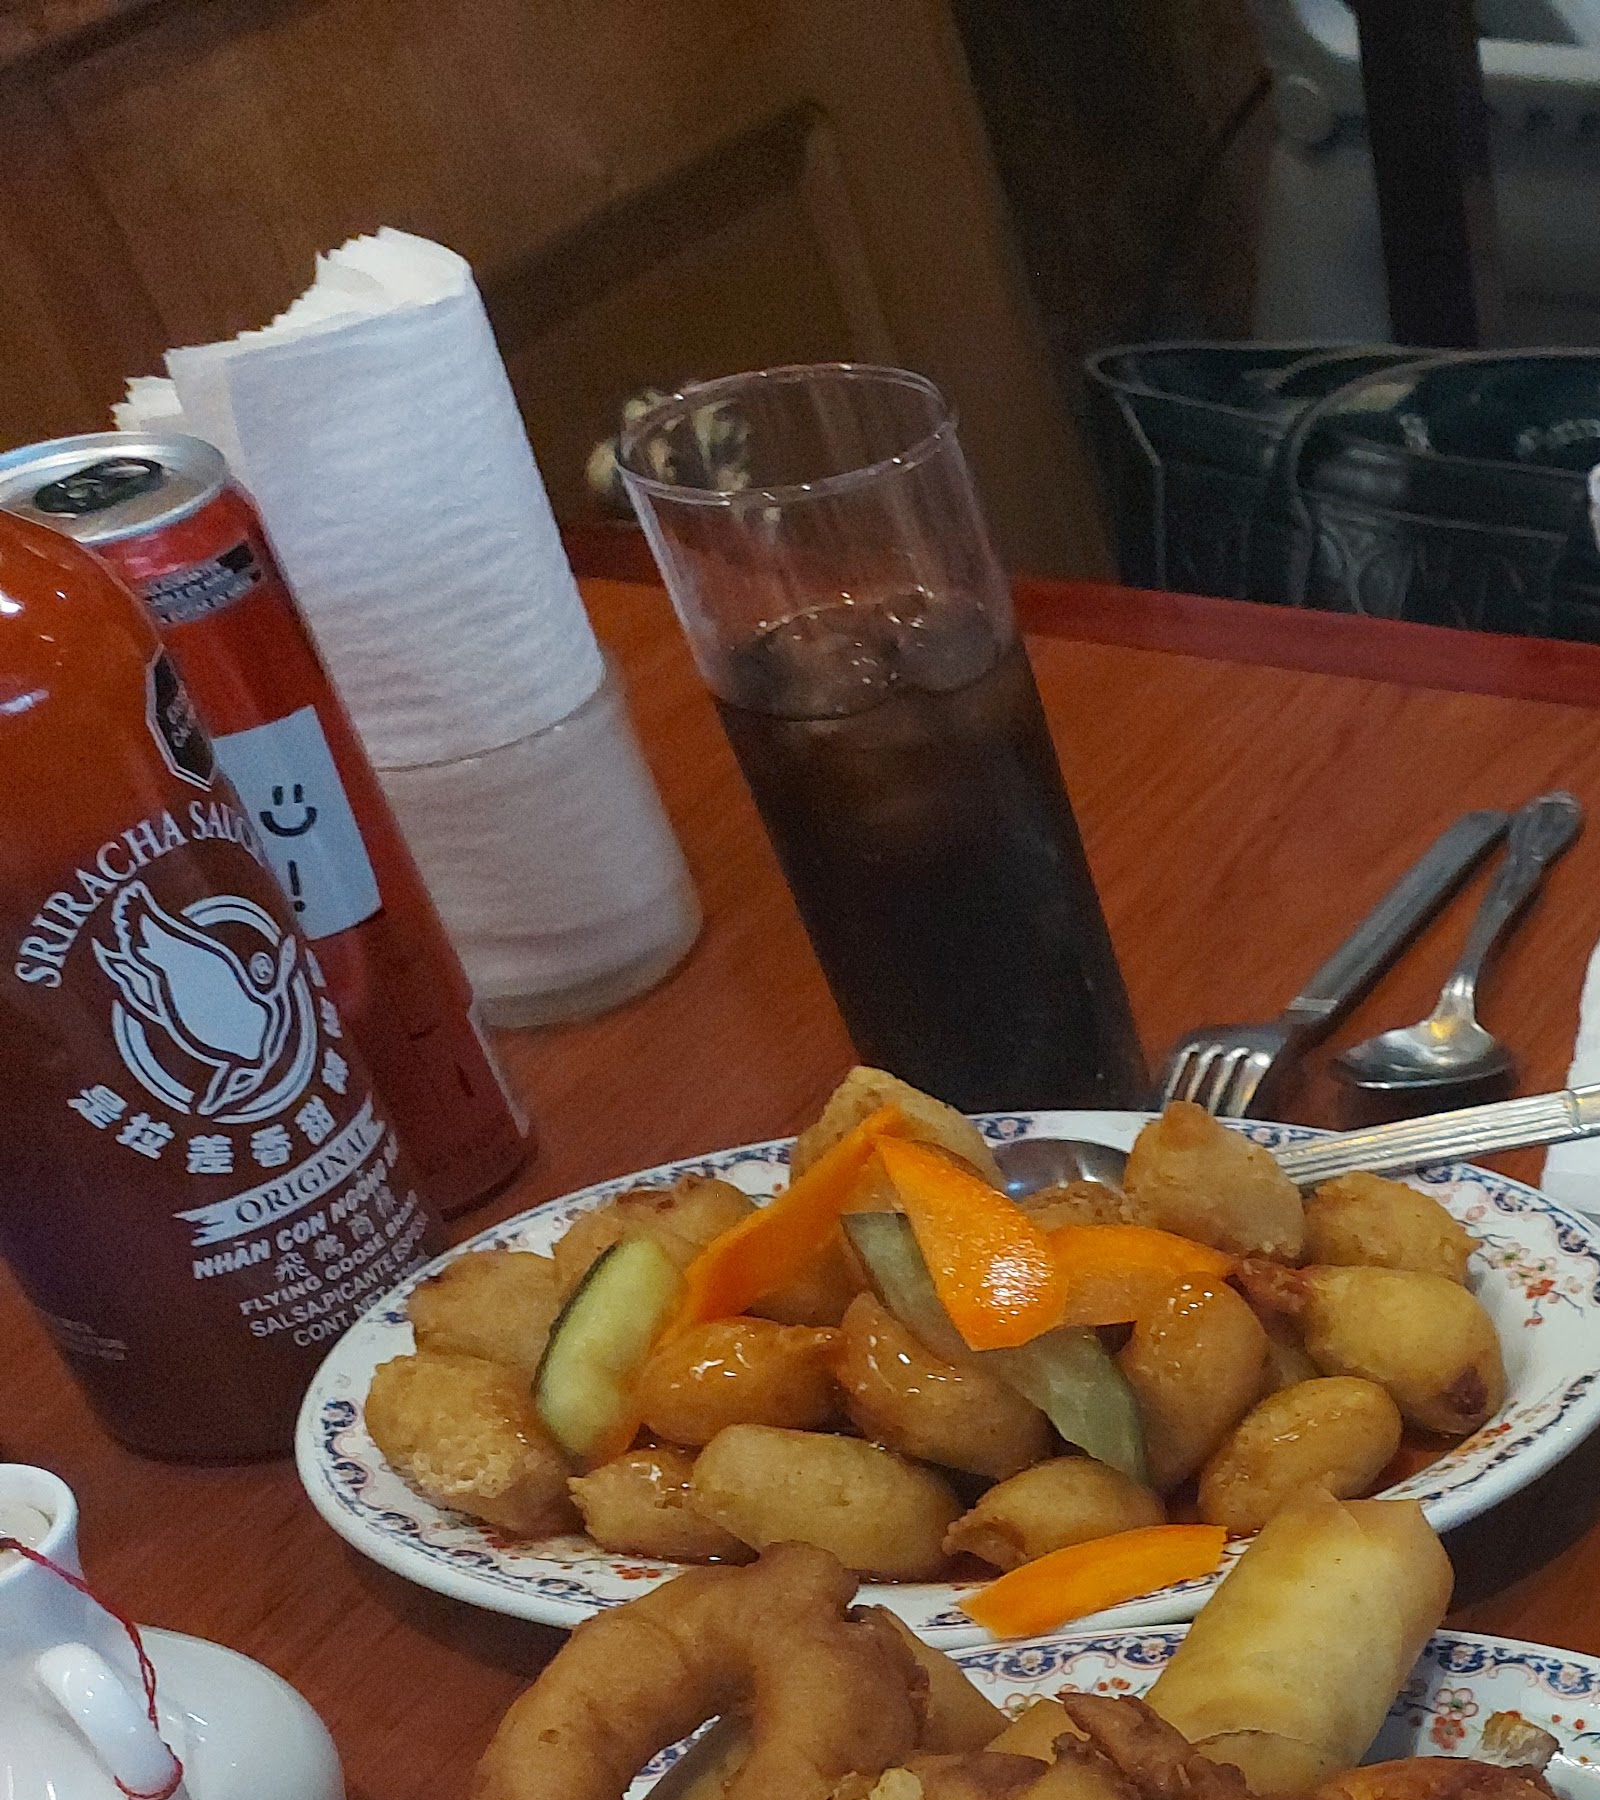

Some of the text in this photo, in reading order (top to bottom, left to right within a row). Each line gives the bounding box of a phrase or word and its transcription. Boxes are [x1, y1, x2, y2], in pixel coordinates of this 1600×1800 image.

[14, 809, 189, 988] SRIRACHA
[275, 1210, 327, 1251] CON
[239, 1275, 323, 1316] FLYING
[321, 1252, 397, 1311] PICANTE
